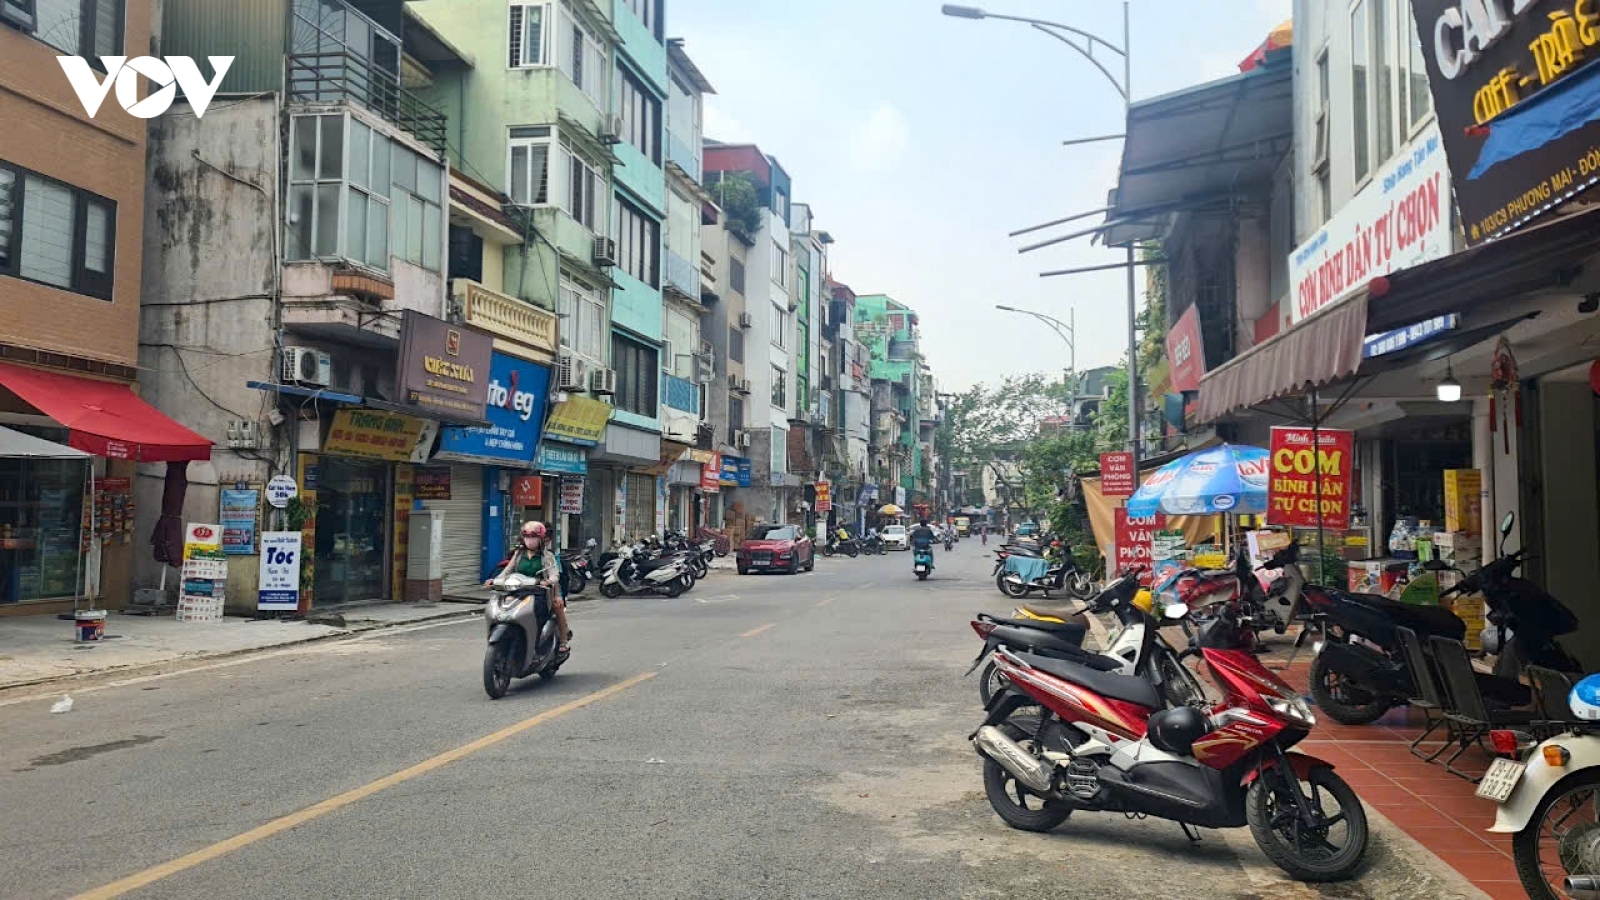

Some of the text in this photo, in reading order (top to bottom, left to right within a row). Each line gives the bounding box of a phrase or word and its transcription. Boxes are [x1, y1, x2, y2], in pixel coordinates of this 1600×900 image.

[1508, 182, 1551, 219] PHƯƠNG
[1550, 167, 1573, 193] MAI
[1319, 250, 1343, 306] BÌNH
[1346, 223, 1372, 287] DÂN
[1375, 200, 1395, 274] TỰ
[1397, 171, 1440, 252] CHỌN
[1274, 446, 1342, 476] CƠM
[1274, 476, 1308, 494] BÌNH
[1274, 495, 1343, 517] TỰ CHỌN
[267, 546, 295, 565] Tóc
